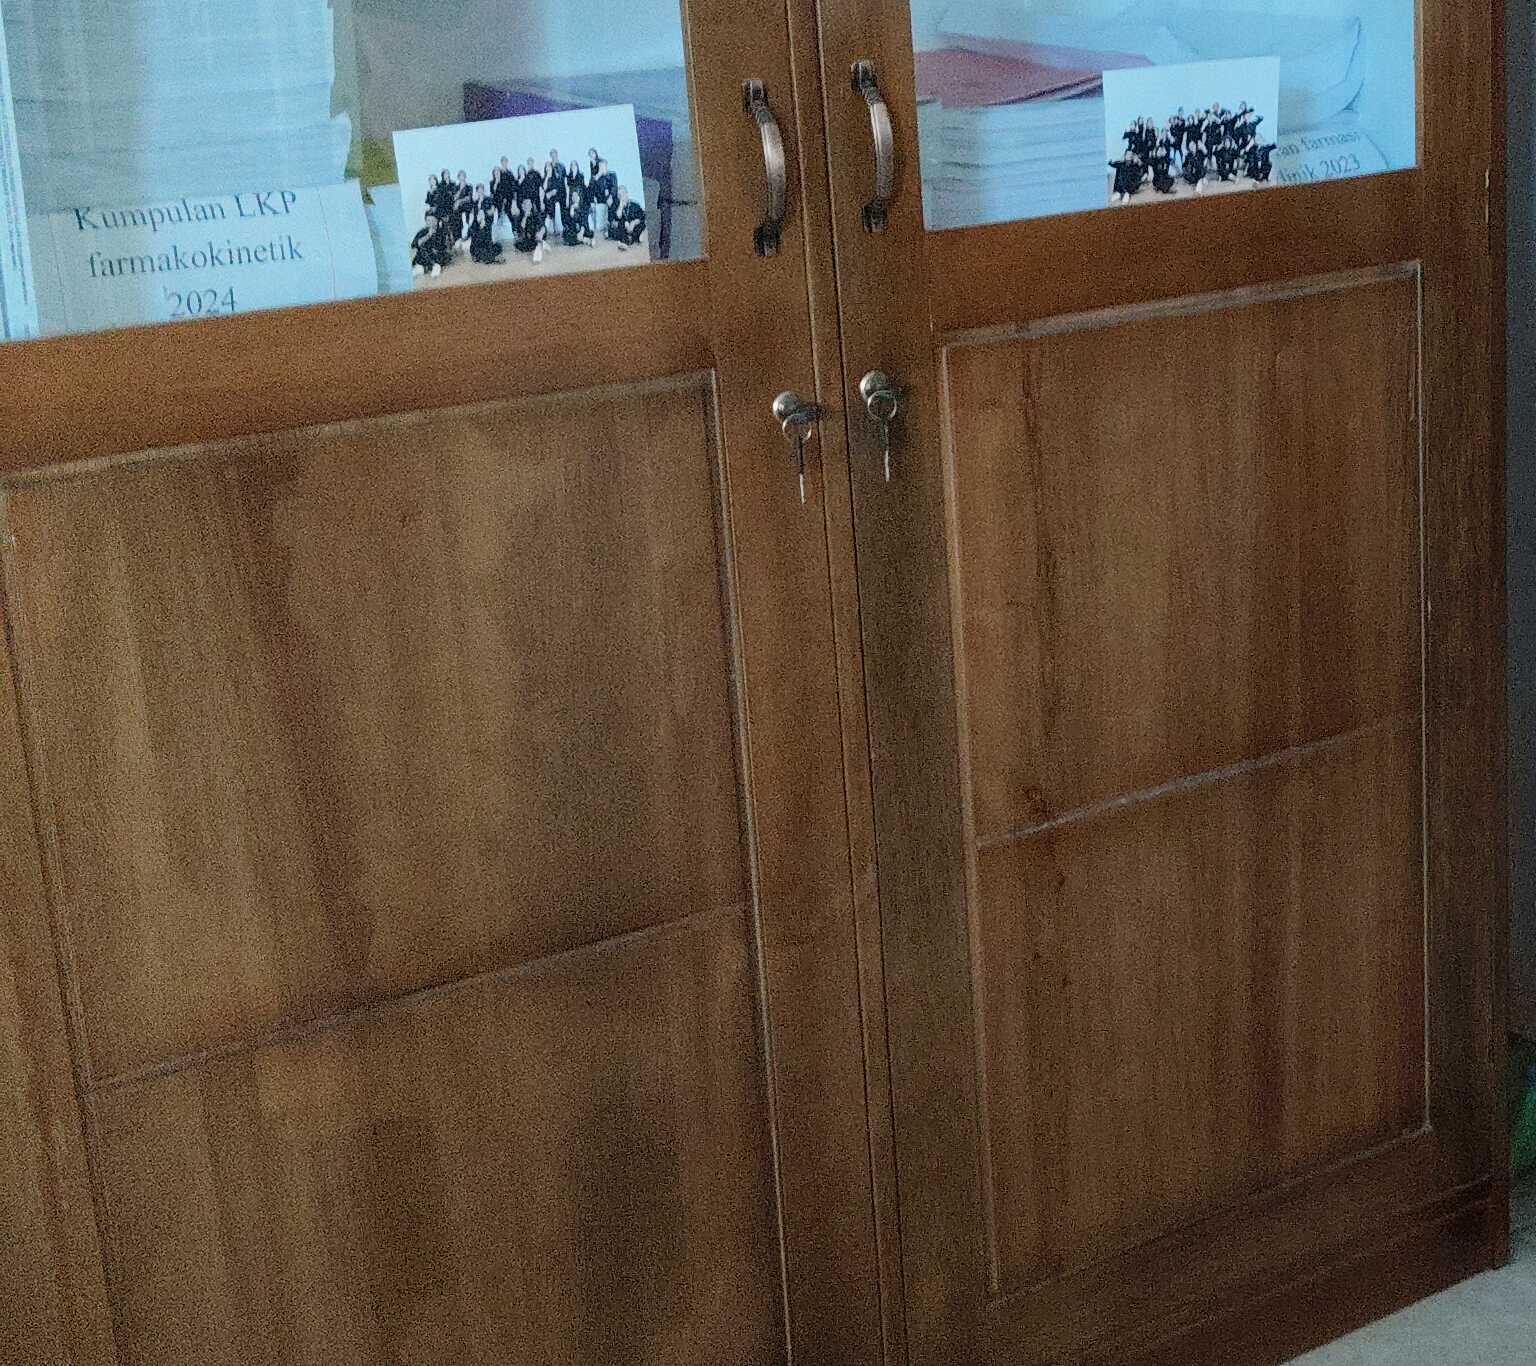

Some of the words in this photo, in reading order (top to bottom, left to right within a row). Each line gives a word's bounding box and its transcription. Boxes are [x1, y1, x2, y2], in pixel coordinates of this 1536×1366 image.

[1300, 130, 1362, 152] farmasi
[1319, 153, 1361, 179] 2023
[73, 197, 227, 232] Kumpulan
[233, 190, 297, 218] LKP
[88, 234, 304, 279] farmakokinetik
[163, 287, 238, 317] 2024
